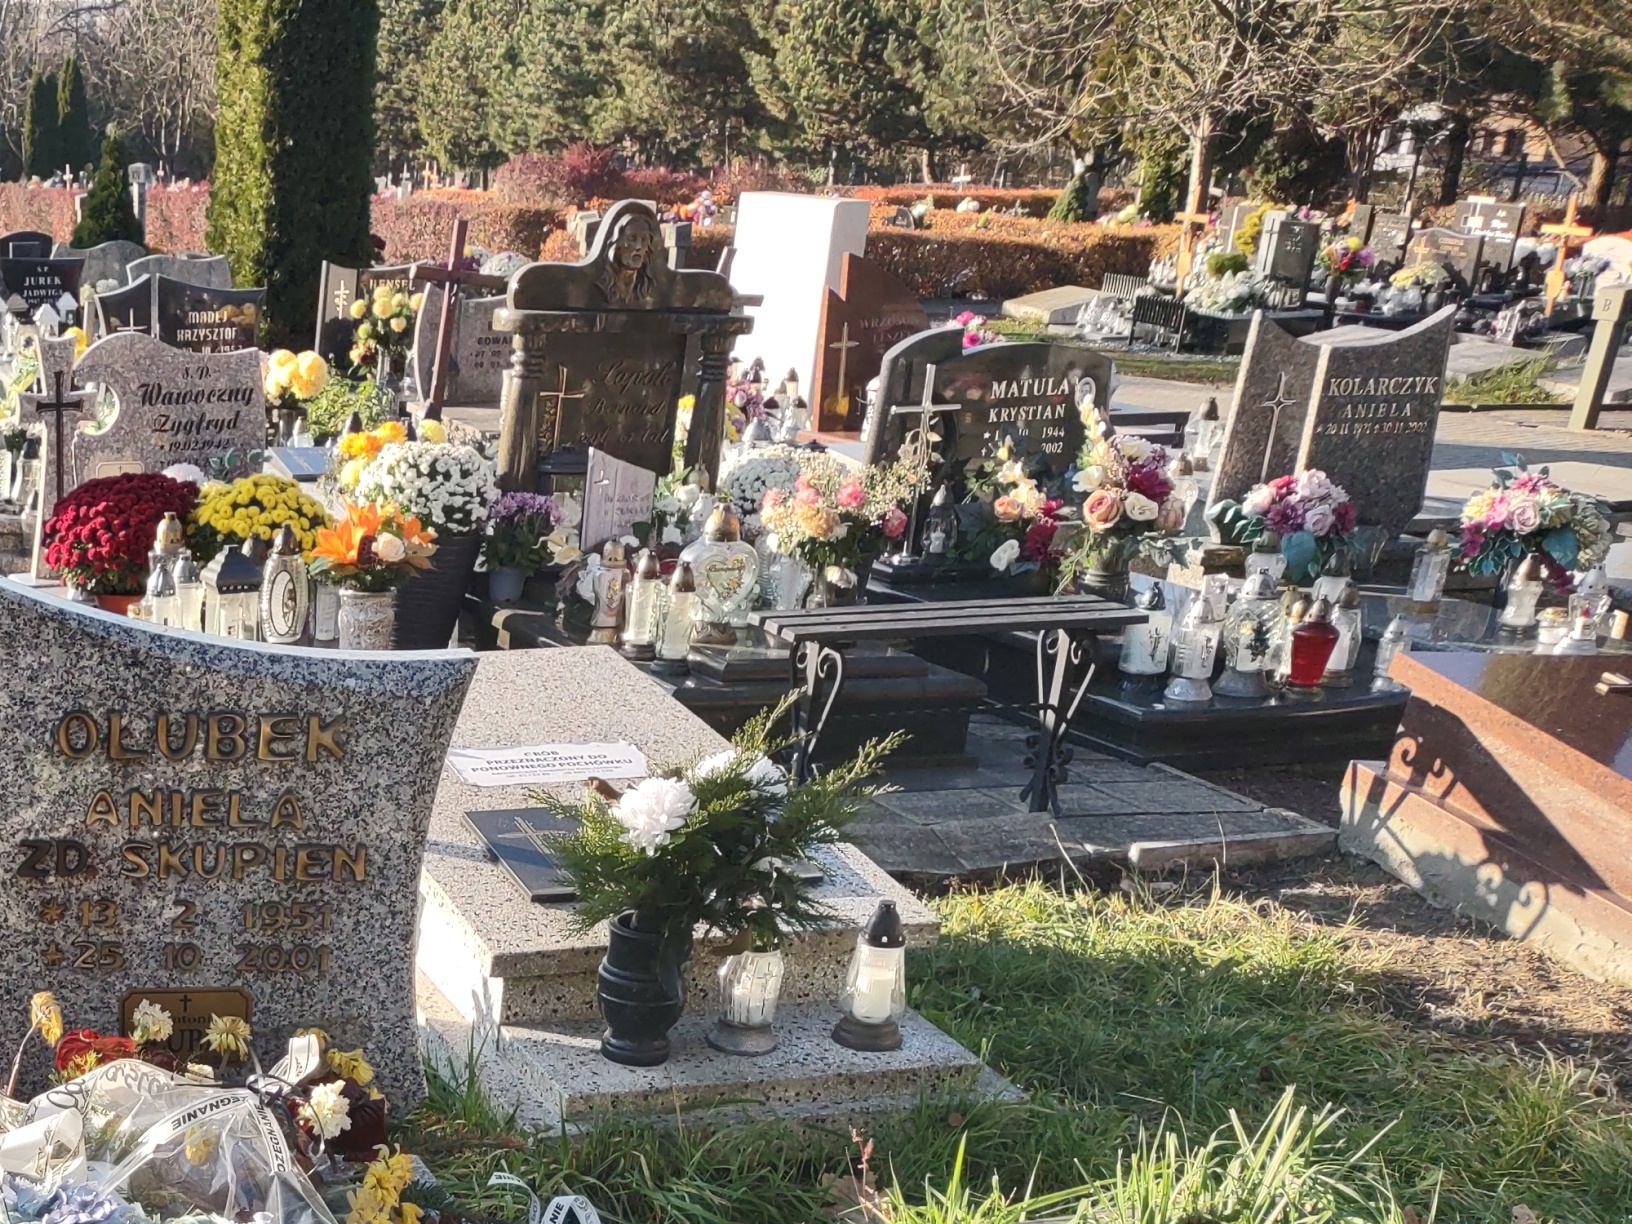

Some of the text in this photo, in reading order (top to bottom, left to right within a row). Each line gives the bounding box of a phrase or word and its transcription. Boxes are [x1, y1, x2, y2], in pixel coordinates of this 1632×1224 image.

[23, 276, 63, 287] JUREK
[188, 311, 229, 324] MADEJ
[176, 327, 238, 342] KRZYSZTOF
[990, 376, 1071, 400] MATULA
[1327, 376, 1439, 396] KOLARCZYK
[987, 403, 1067, 424] KRYSTIAN
[1342, 402, 1412, 419] ANIELA
[1041, 425, 1066, 439] 1944
[85, 788, 305, 831] ANIELA
[77, 902, 334, 931] 13 2 1951
[72, 941, 332, 974] 25 10 2001
